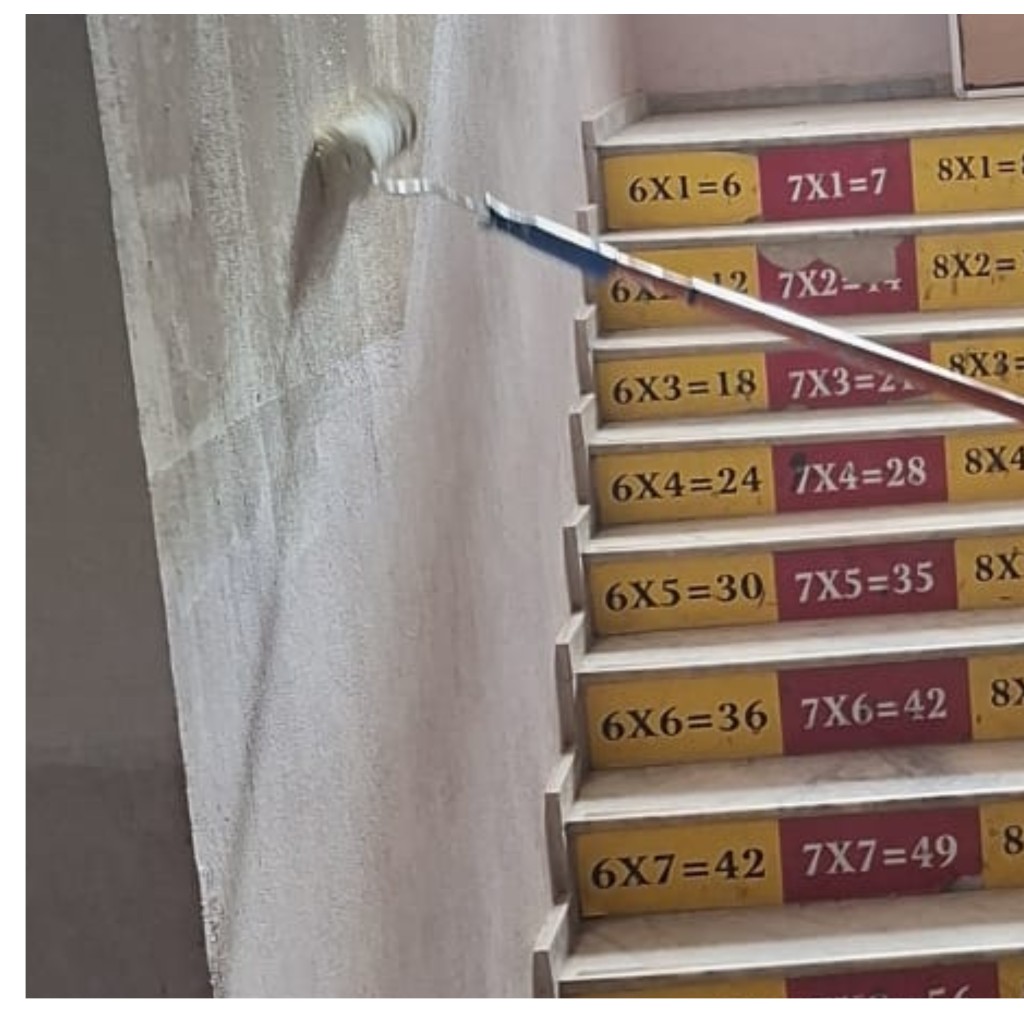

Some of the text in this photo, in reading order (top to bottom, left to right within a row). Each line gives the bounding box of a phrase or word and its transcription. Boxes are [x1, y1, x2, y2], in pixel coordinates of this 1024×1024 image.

[628, 173, 741, 203] 6X1=6
[787, 167, 887, 203] 7X1=7
[612, 368, 757, 405] 6X3=18
[610, 465, 764, 503] 6X4=24
[795, 455, 928, 495] 7X4=28
[604, 570, 764, 613] 6X5=30
[795, 560, 935, 605] 7X5=35
[601, 699, 768, 742] 6X6=36
[801, 686, 948, 731] 7X6=42
[591, 847, 766, 890] 6X7=42
[802, 833, 959, 877] 7X7=49
